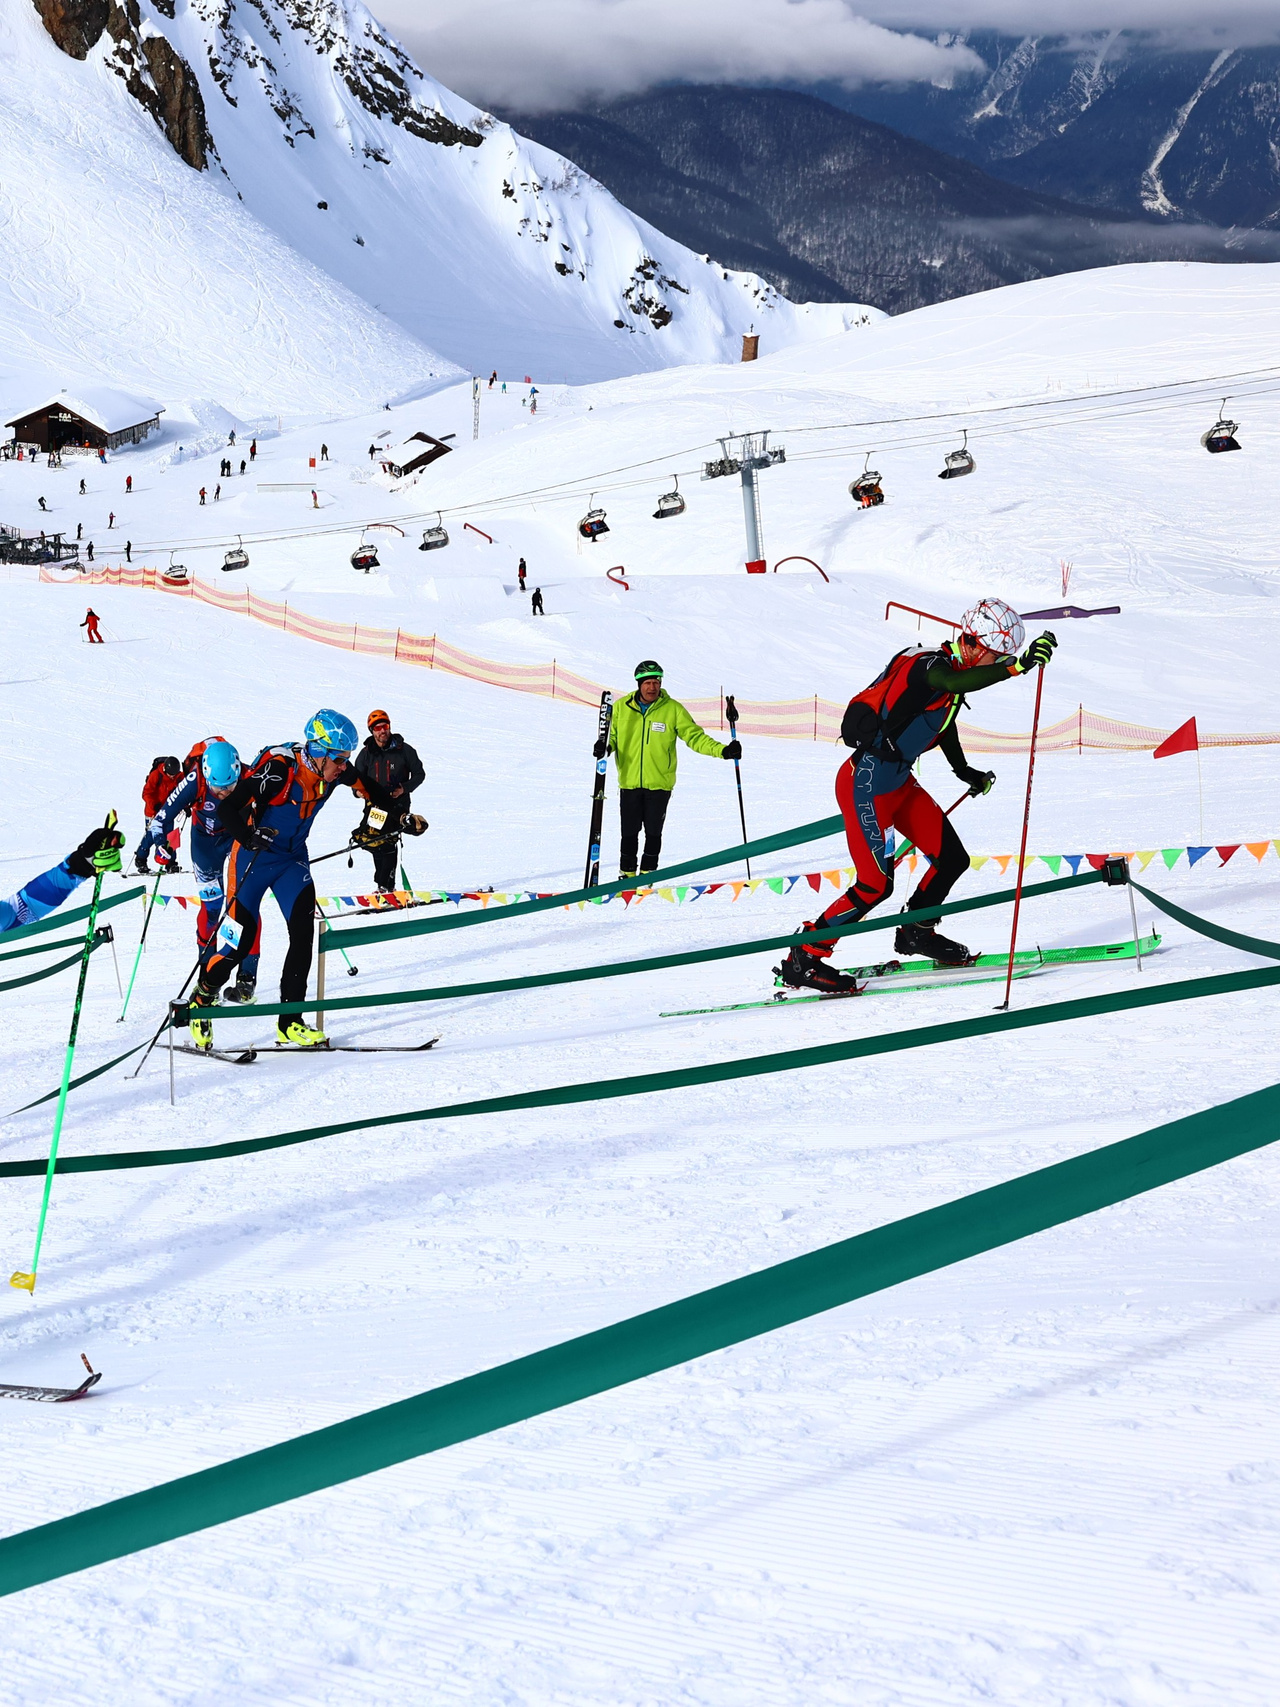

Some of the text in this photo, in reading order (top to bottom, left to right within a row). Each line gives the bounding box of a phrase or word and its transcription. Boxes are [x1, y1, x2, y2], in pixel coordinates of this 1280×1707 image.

[600, 703, 608, 735] TRAB
[166, 771, 197, 807] SKIMO
[370, 811, 386, 822] 2013
[203, 888, 217, 898] 14
[227, 929, 234, 940] 3
